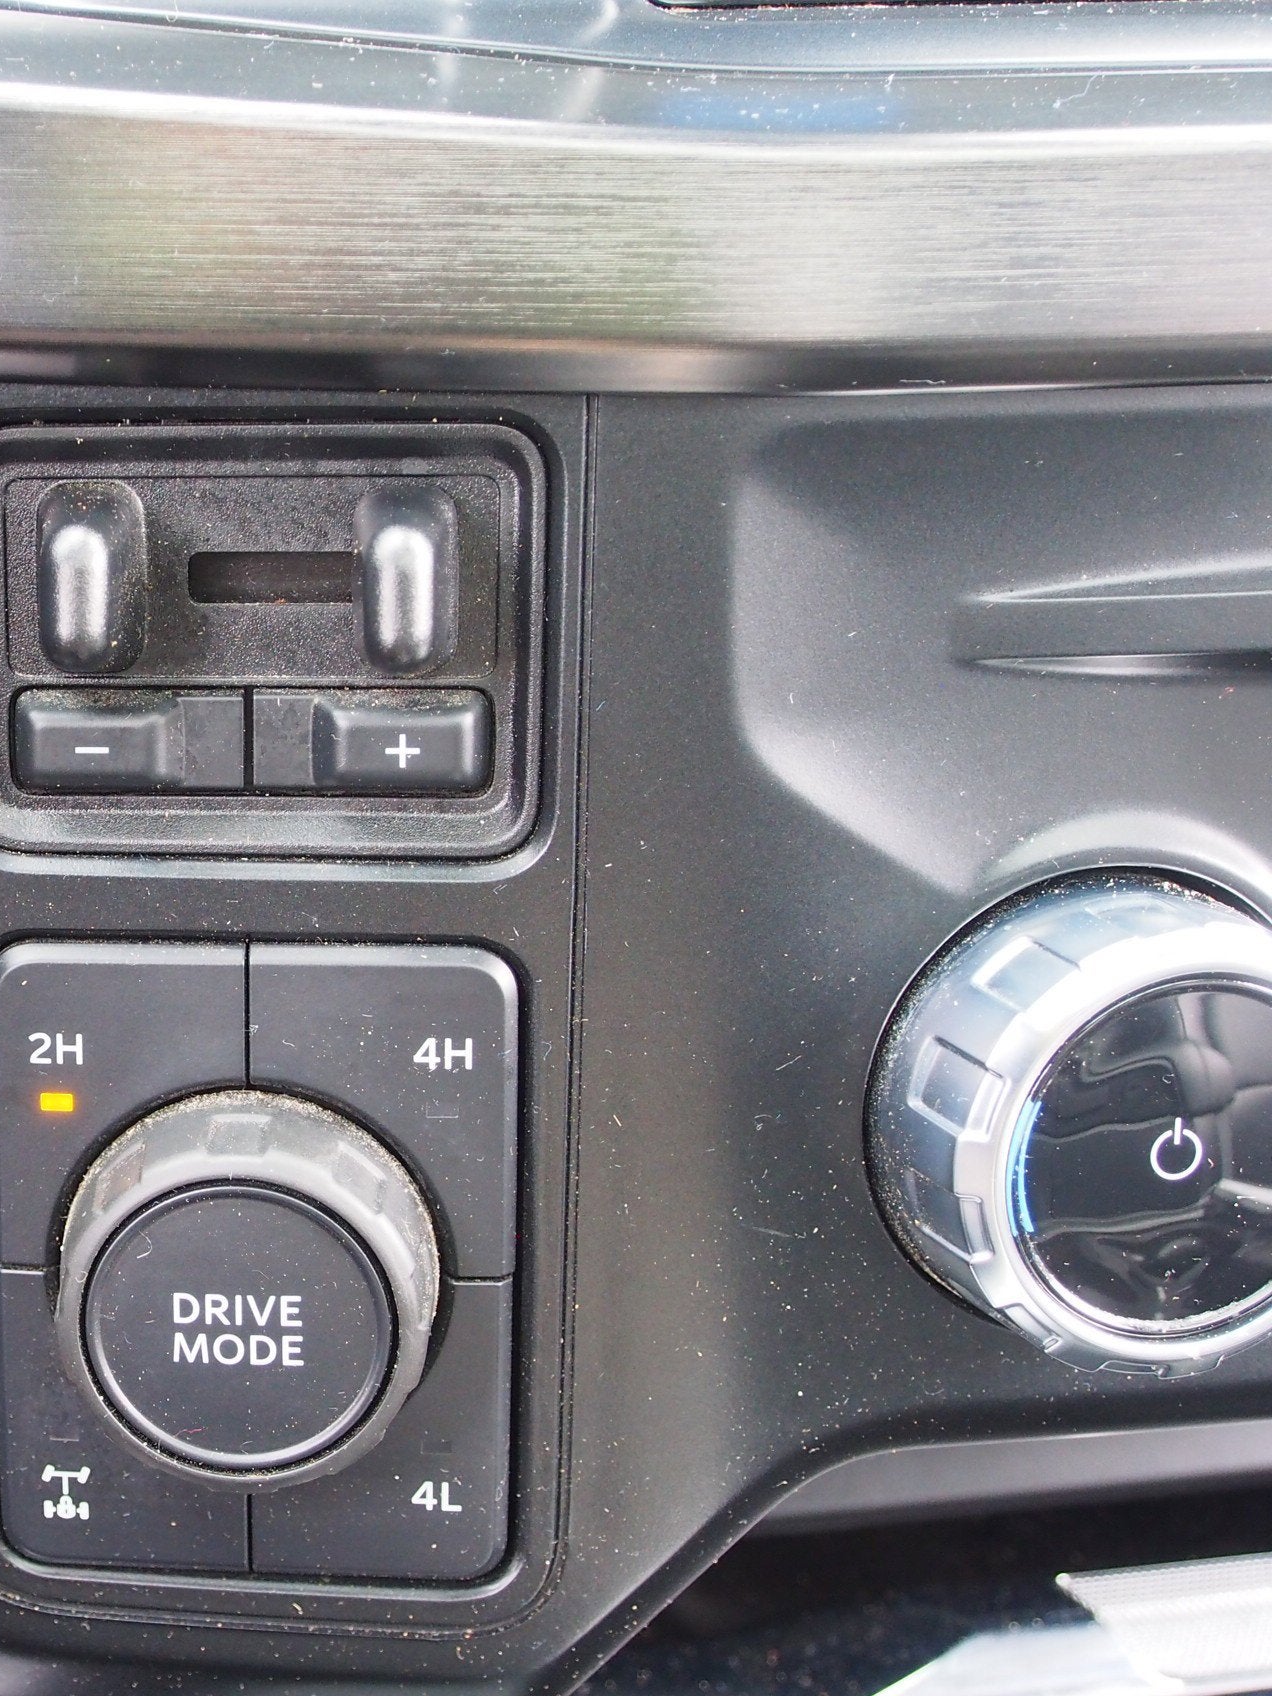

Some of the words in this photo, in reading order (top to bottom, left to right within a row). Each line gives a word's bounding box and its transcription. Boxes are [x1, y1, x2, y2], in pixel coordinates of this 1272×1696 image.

[28, 1032, 84, 1066] 2H
[413, 1037, 474, 1070] 4H
[172, 1292, 303, 1328] DRIVE
[172, 1332, 305, 1367] MODE
[411, 1481, 463, 1513] 4L
